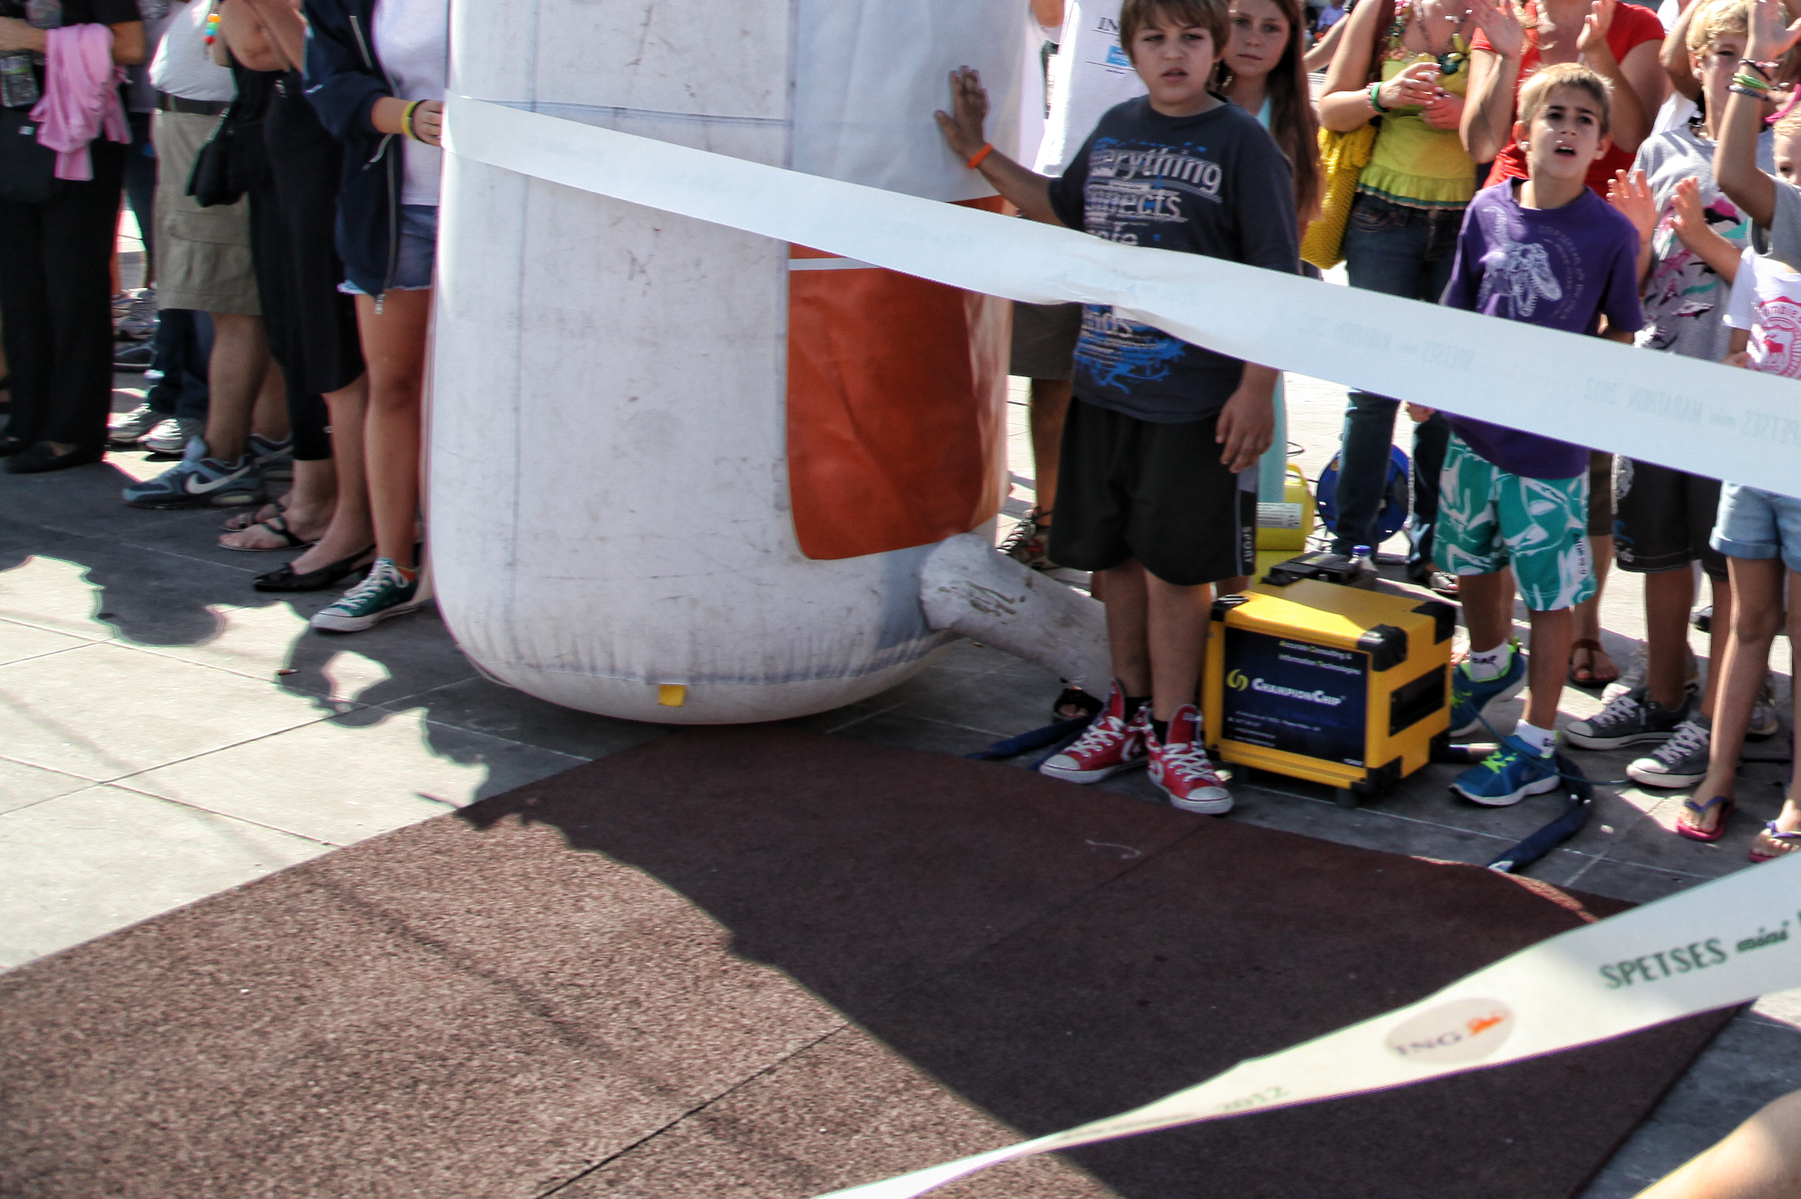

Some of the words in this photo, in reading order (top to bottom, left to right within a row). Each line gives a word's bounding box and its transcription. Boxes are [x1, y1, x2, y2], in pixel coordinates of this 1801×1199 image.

[1097, 16, 1121, 32] IN
[1600, 938, 1728, 991] SPETSES
[1736, 919, 1790, 953] mini
